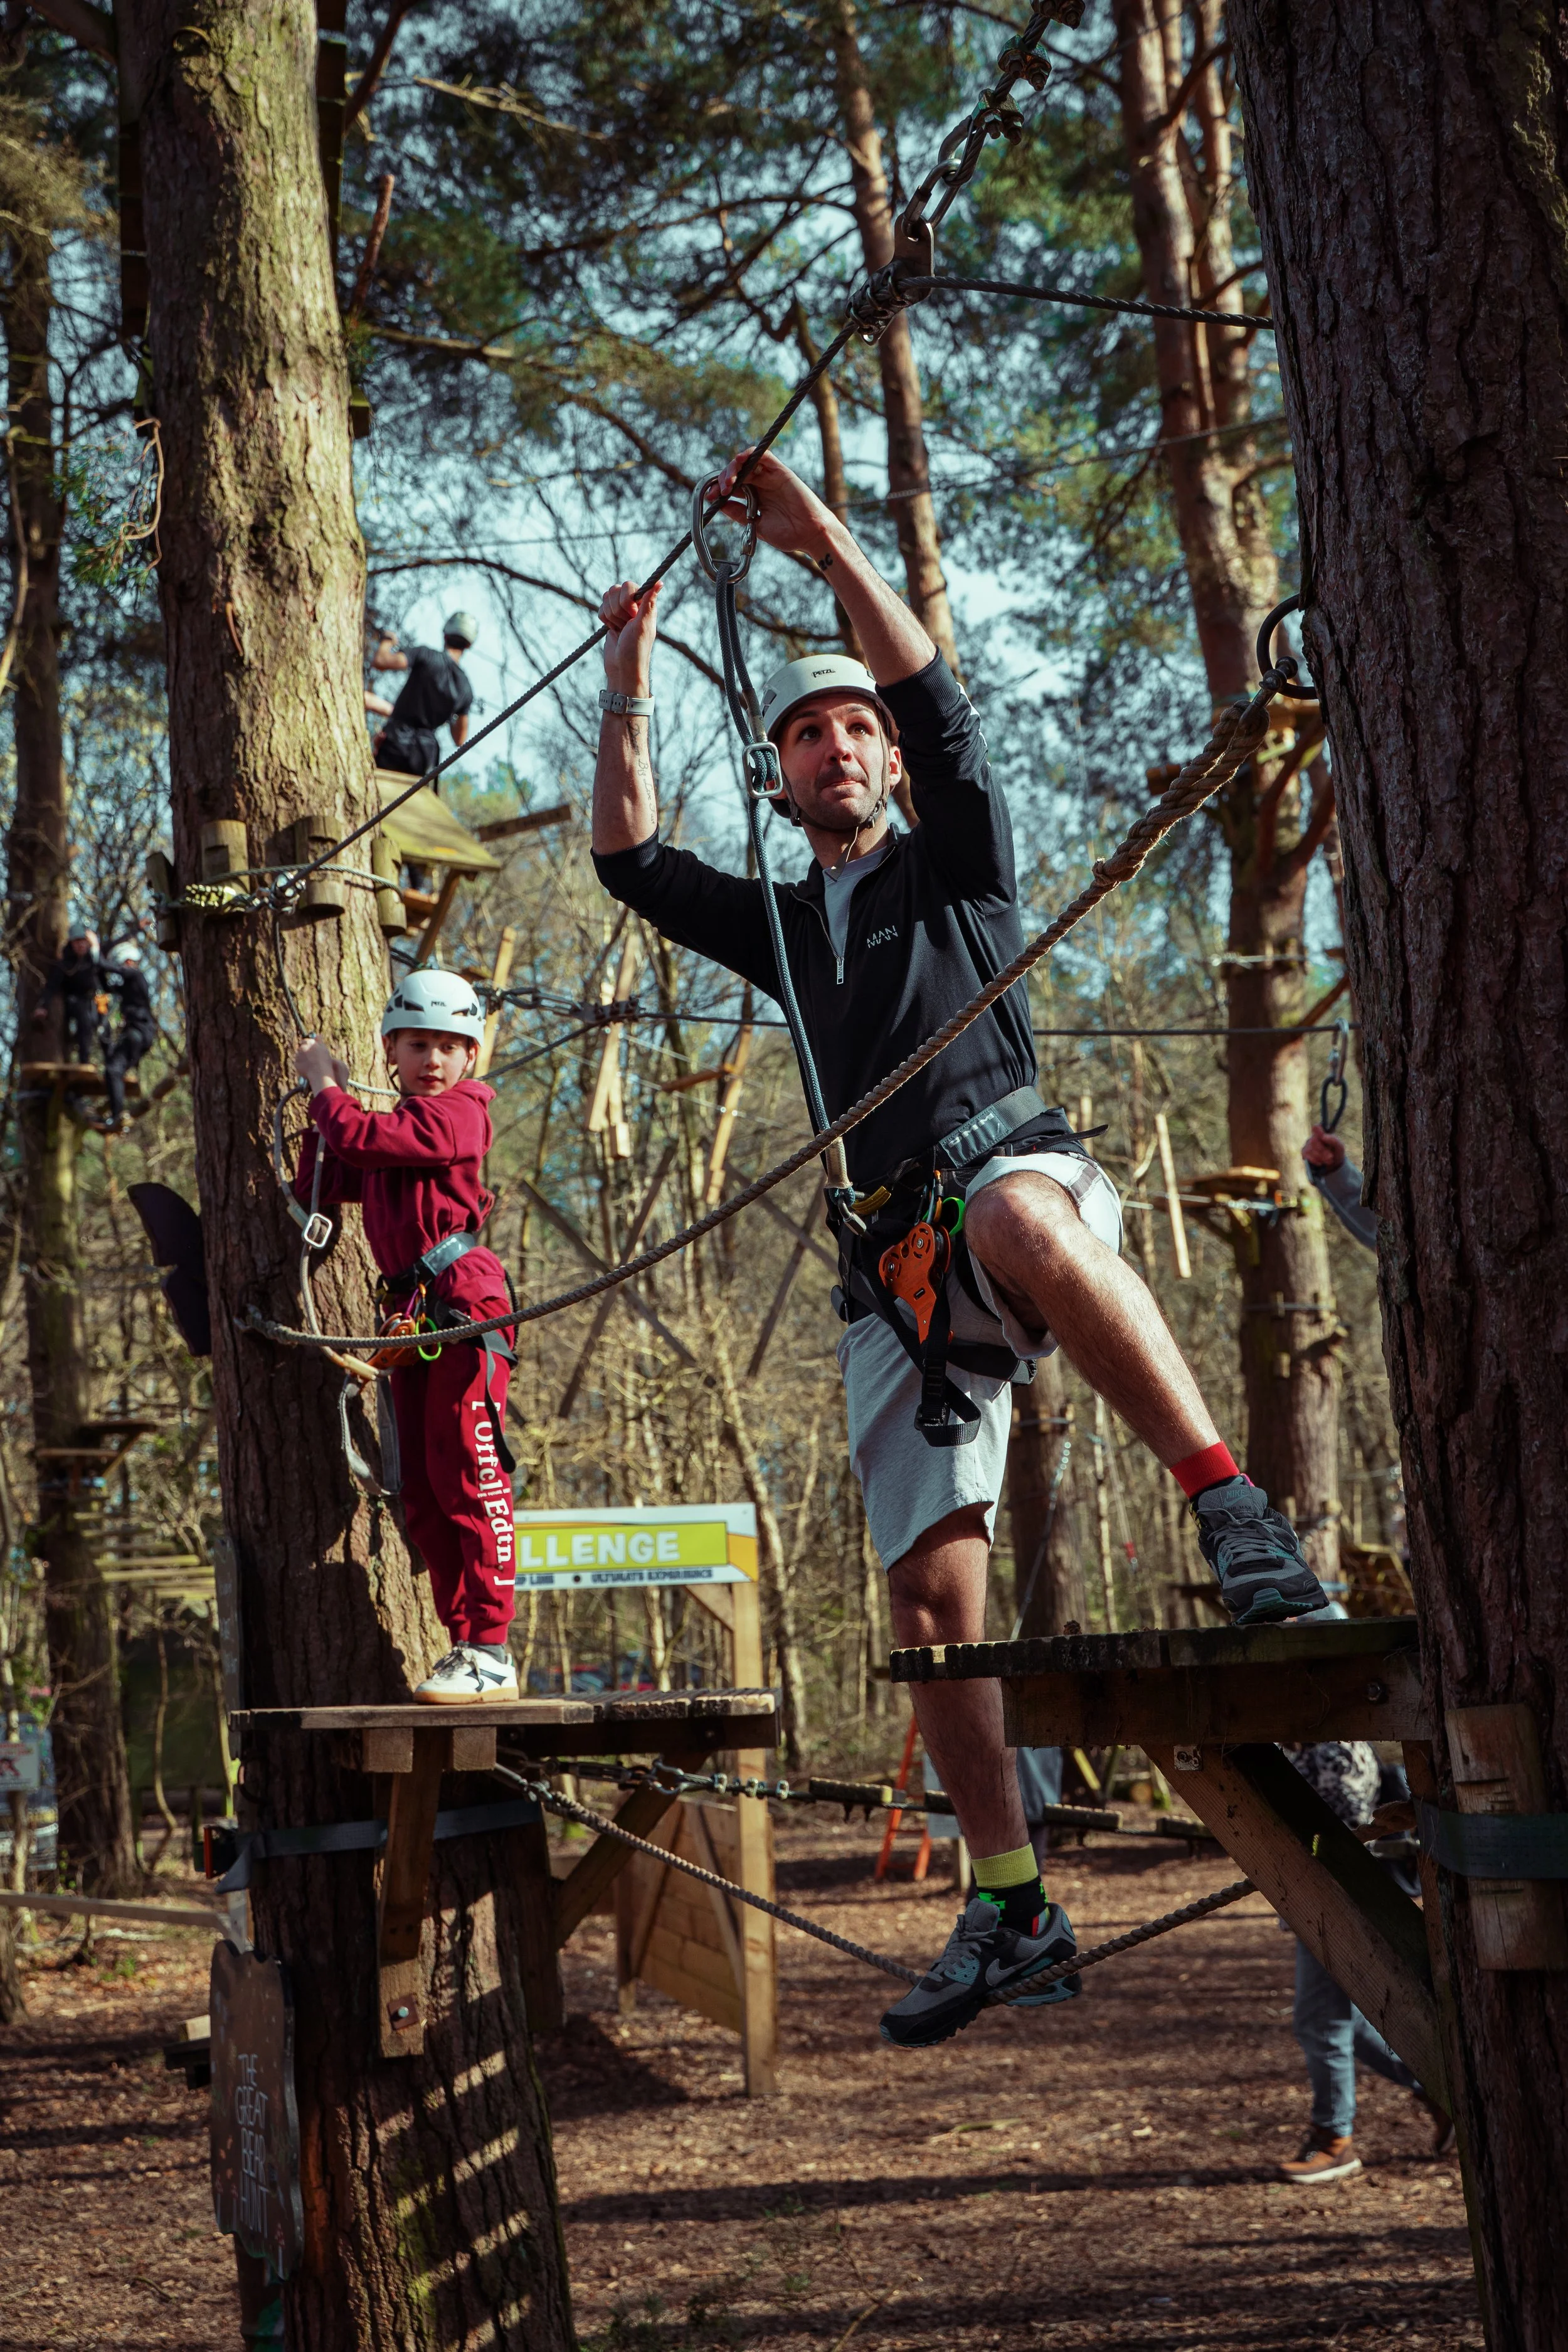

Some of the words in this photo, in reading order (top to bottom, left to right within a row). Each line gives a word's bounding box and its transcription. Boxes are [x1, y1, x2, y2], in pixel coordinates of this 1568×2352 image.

[812, 669, 836, 678] PETZL
[867, 925, 898, 948] MAN
[1227, 1490, 1244, 1498] NIKE
[516, 1532, 679, 1567] LLENGE
[238, 2054, 258, 2086] THE
[236, 2086, 268, 2129] GREAT
